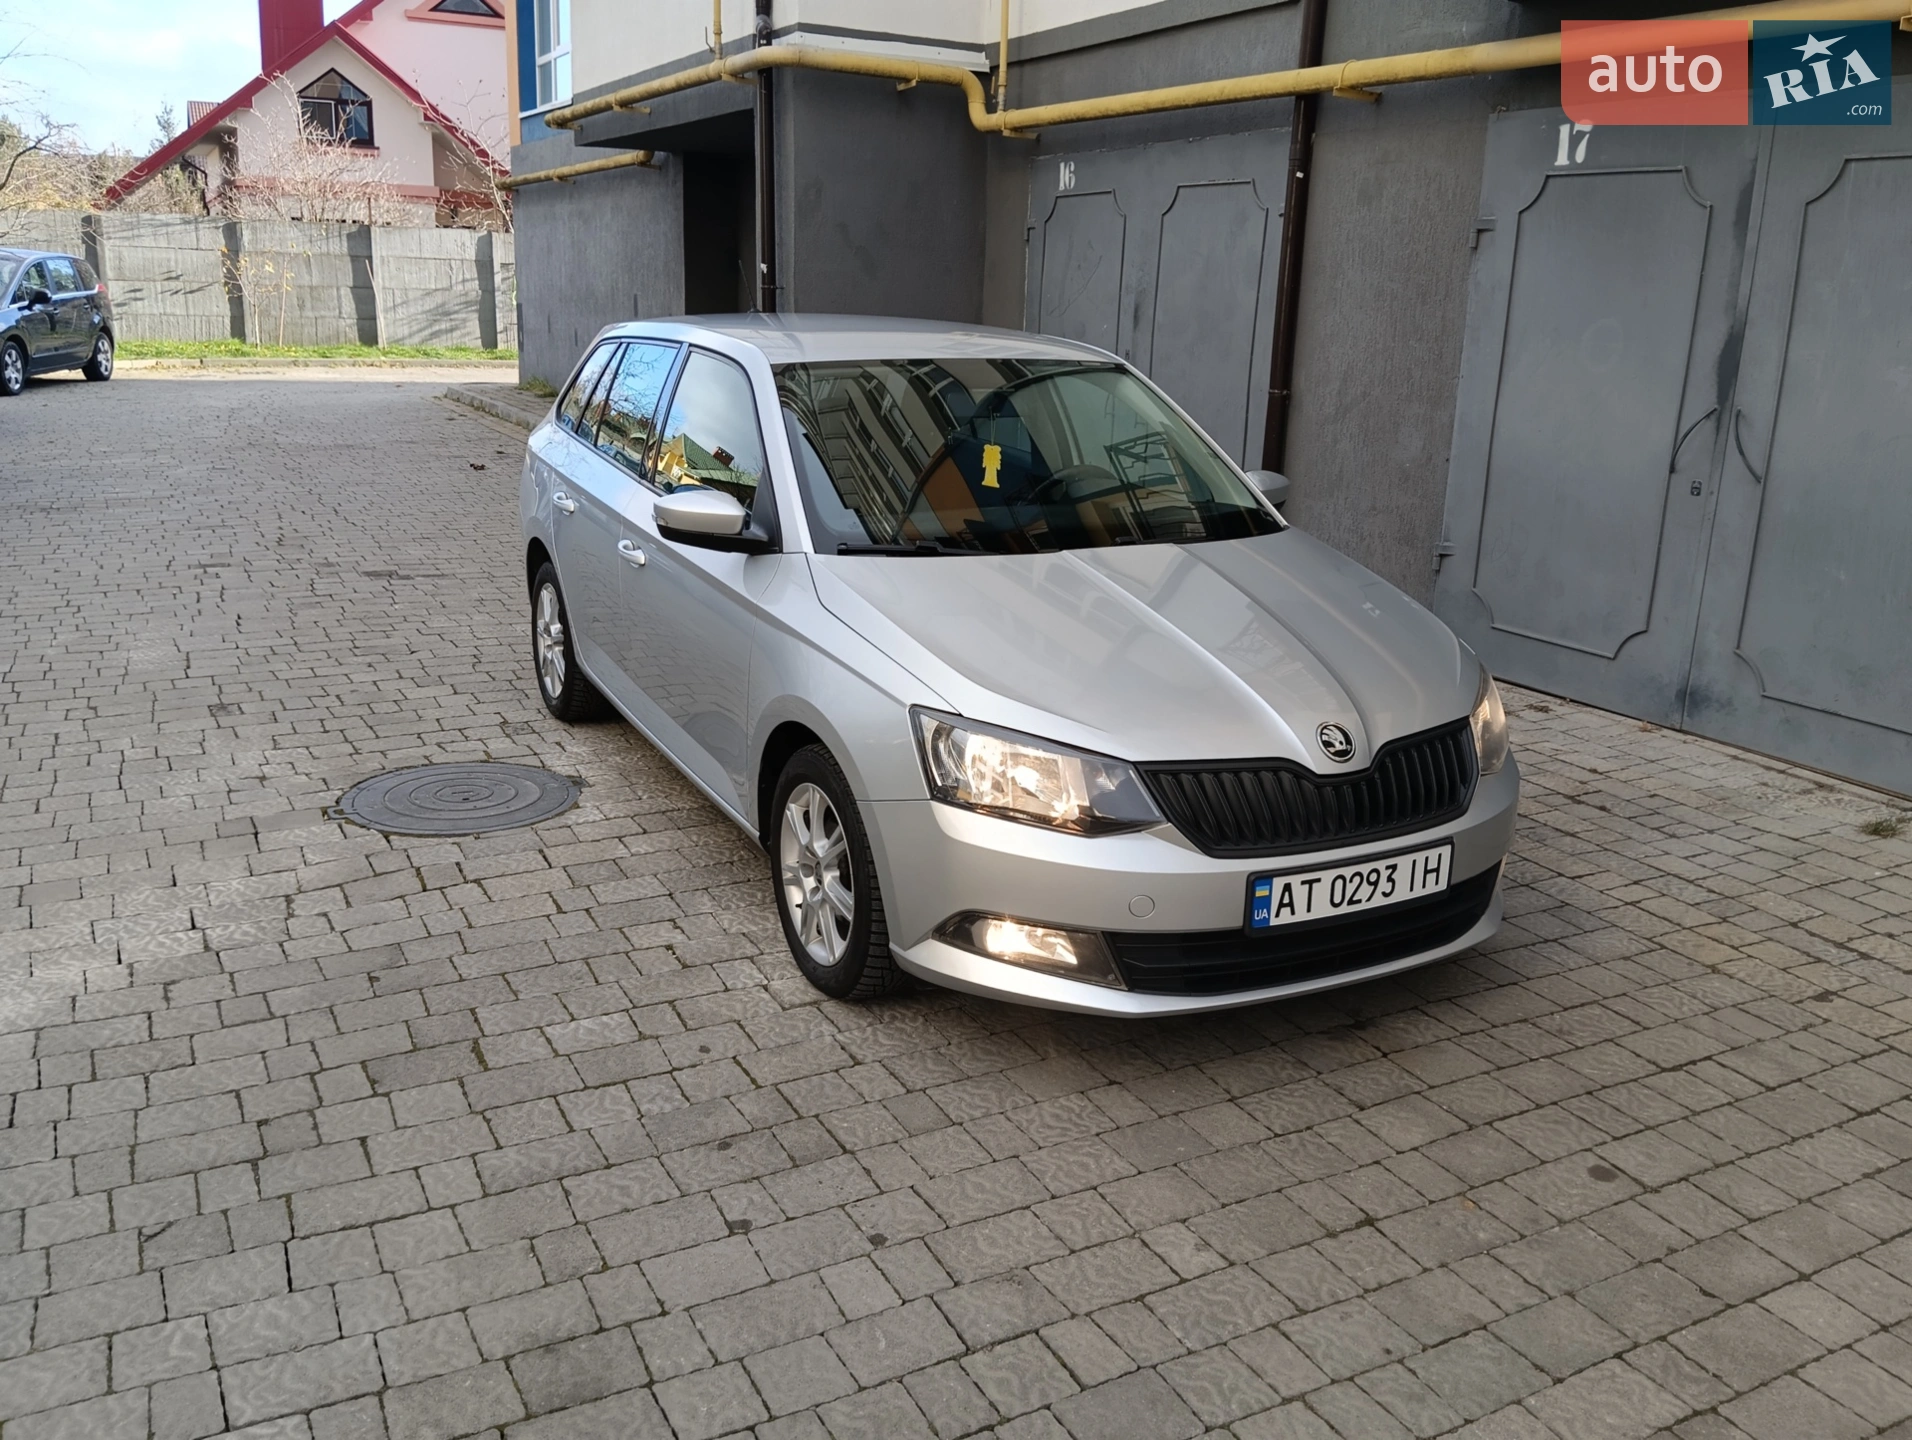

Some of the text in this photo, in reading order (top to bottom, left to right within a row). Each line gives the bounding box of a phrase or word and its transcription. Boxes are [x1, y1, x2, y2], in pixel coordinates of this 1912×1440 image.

[1554, 119, 1594, 166] 17
[1058, 161, 1076, 191] 16
[1274, 852, 1443, 919] AT 0293 IH
[1254, 908, 1269, 920] UA
